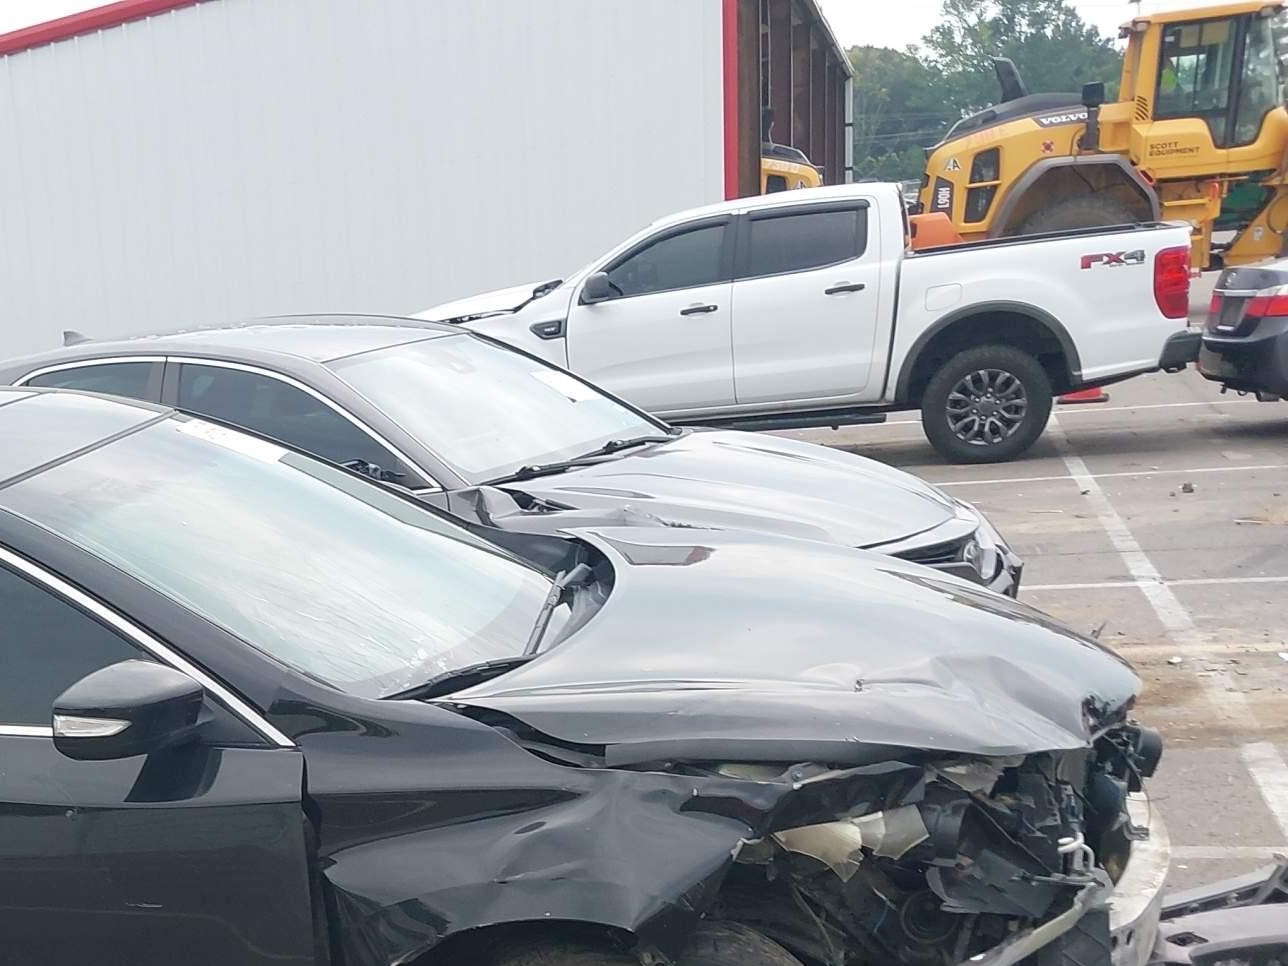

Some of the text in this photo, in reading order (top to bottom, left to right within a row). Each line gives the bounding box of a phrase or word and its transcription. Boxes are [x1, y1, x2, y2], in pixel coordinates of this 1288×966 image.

[1039, 112, 1088, 125] VOLVO
[1149, 141, 1179, 150] SCOTT
[1149, 146, 1200, 157] EQUIPMENT
[937, 187, 951, 209] L90H
[1081, 249, 1145, 269] FX4
